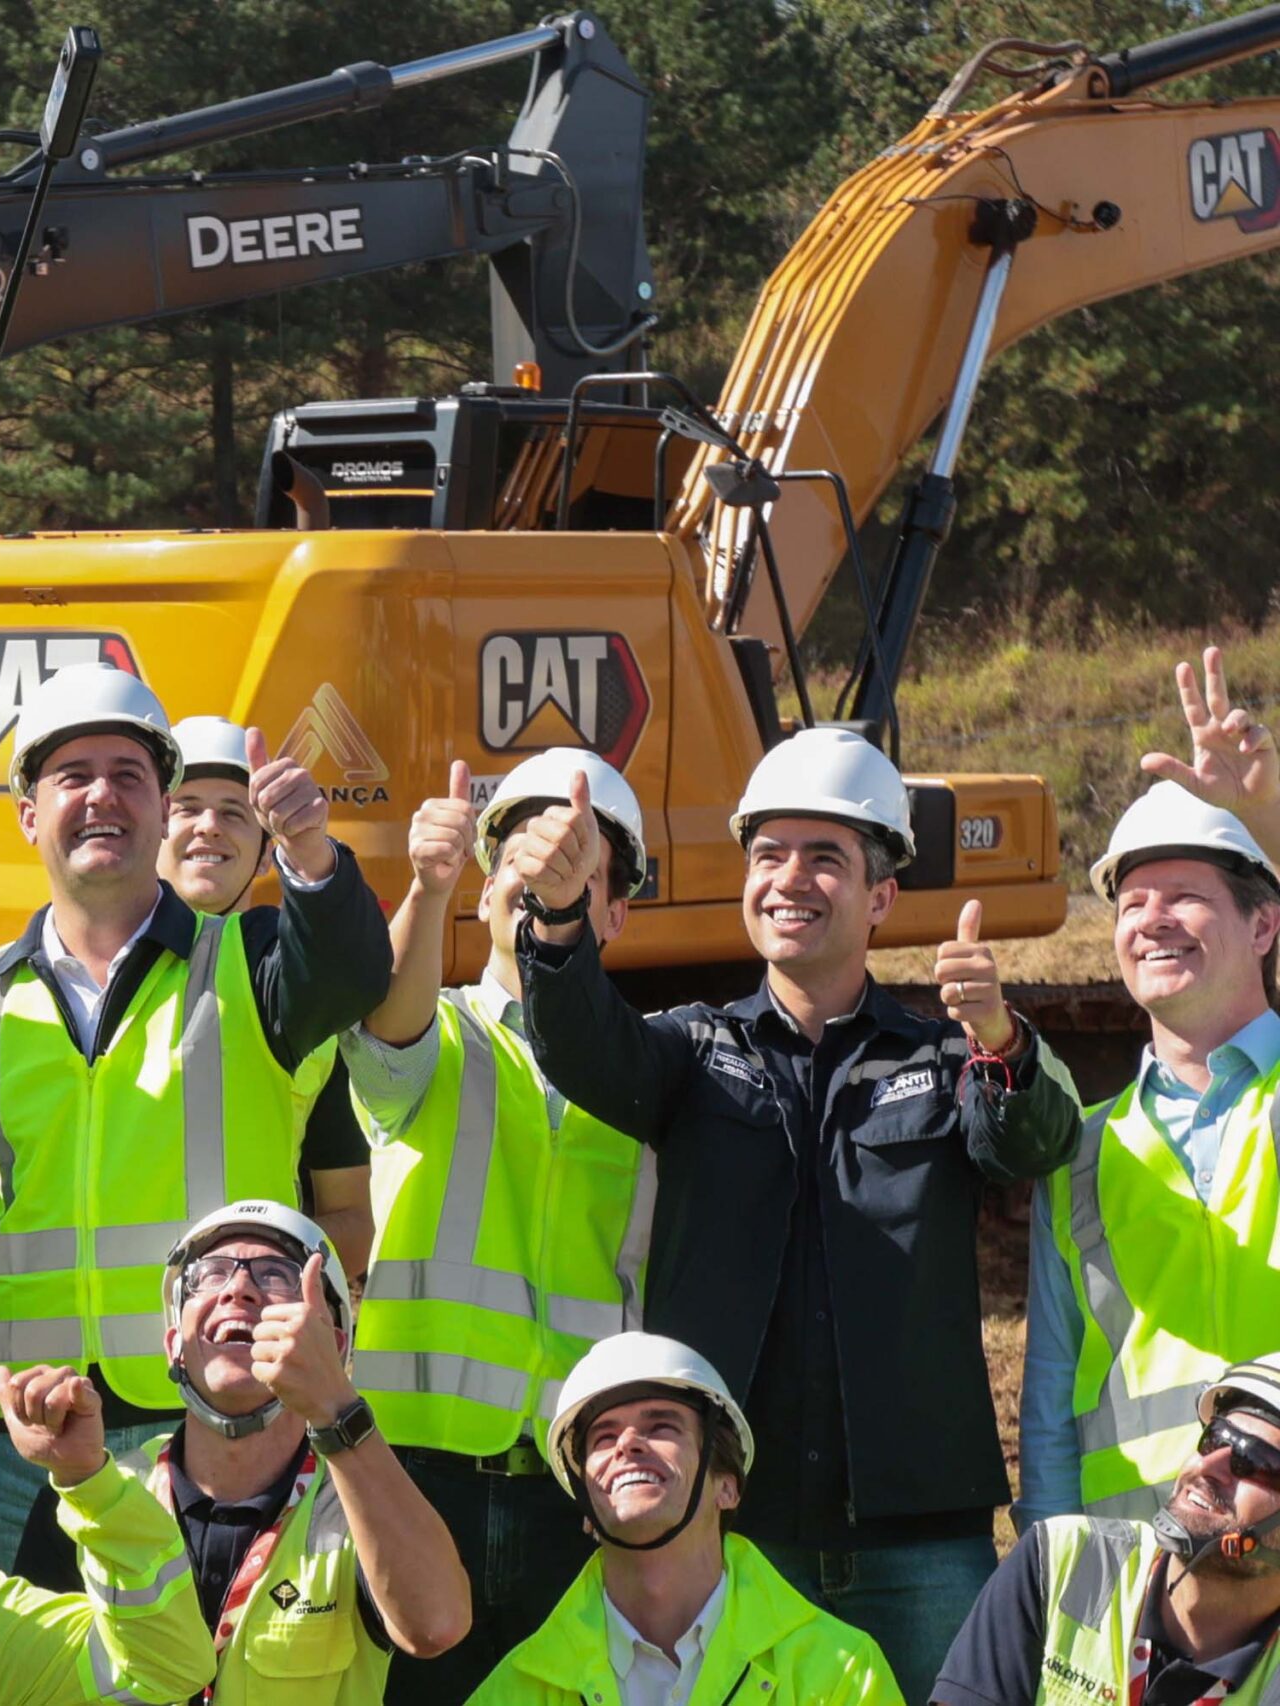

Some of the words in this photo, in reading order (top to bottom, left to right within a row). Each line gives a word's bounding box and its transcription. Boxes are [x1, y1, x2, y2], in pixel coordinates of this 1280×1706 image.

[1190, 131, 1265, 218] CAT
[187, 208, 363, 268] DEERE
[331, 461, 404, 477] DROMOS
[482, 636, 607, 748] CAT
[961, 818, 994, 849] 320
